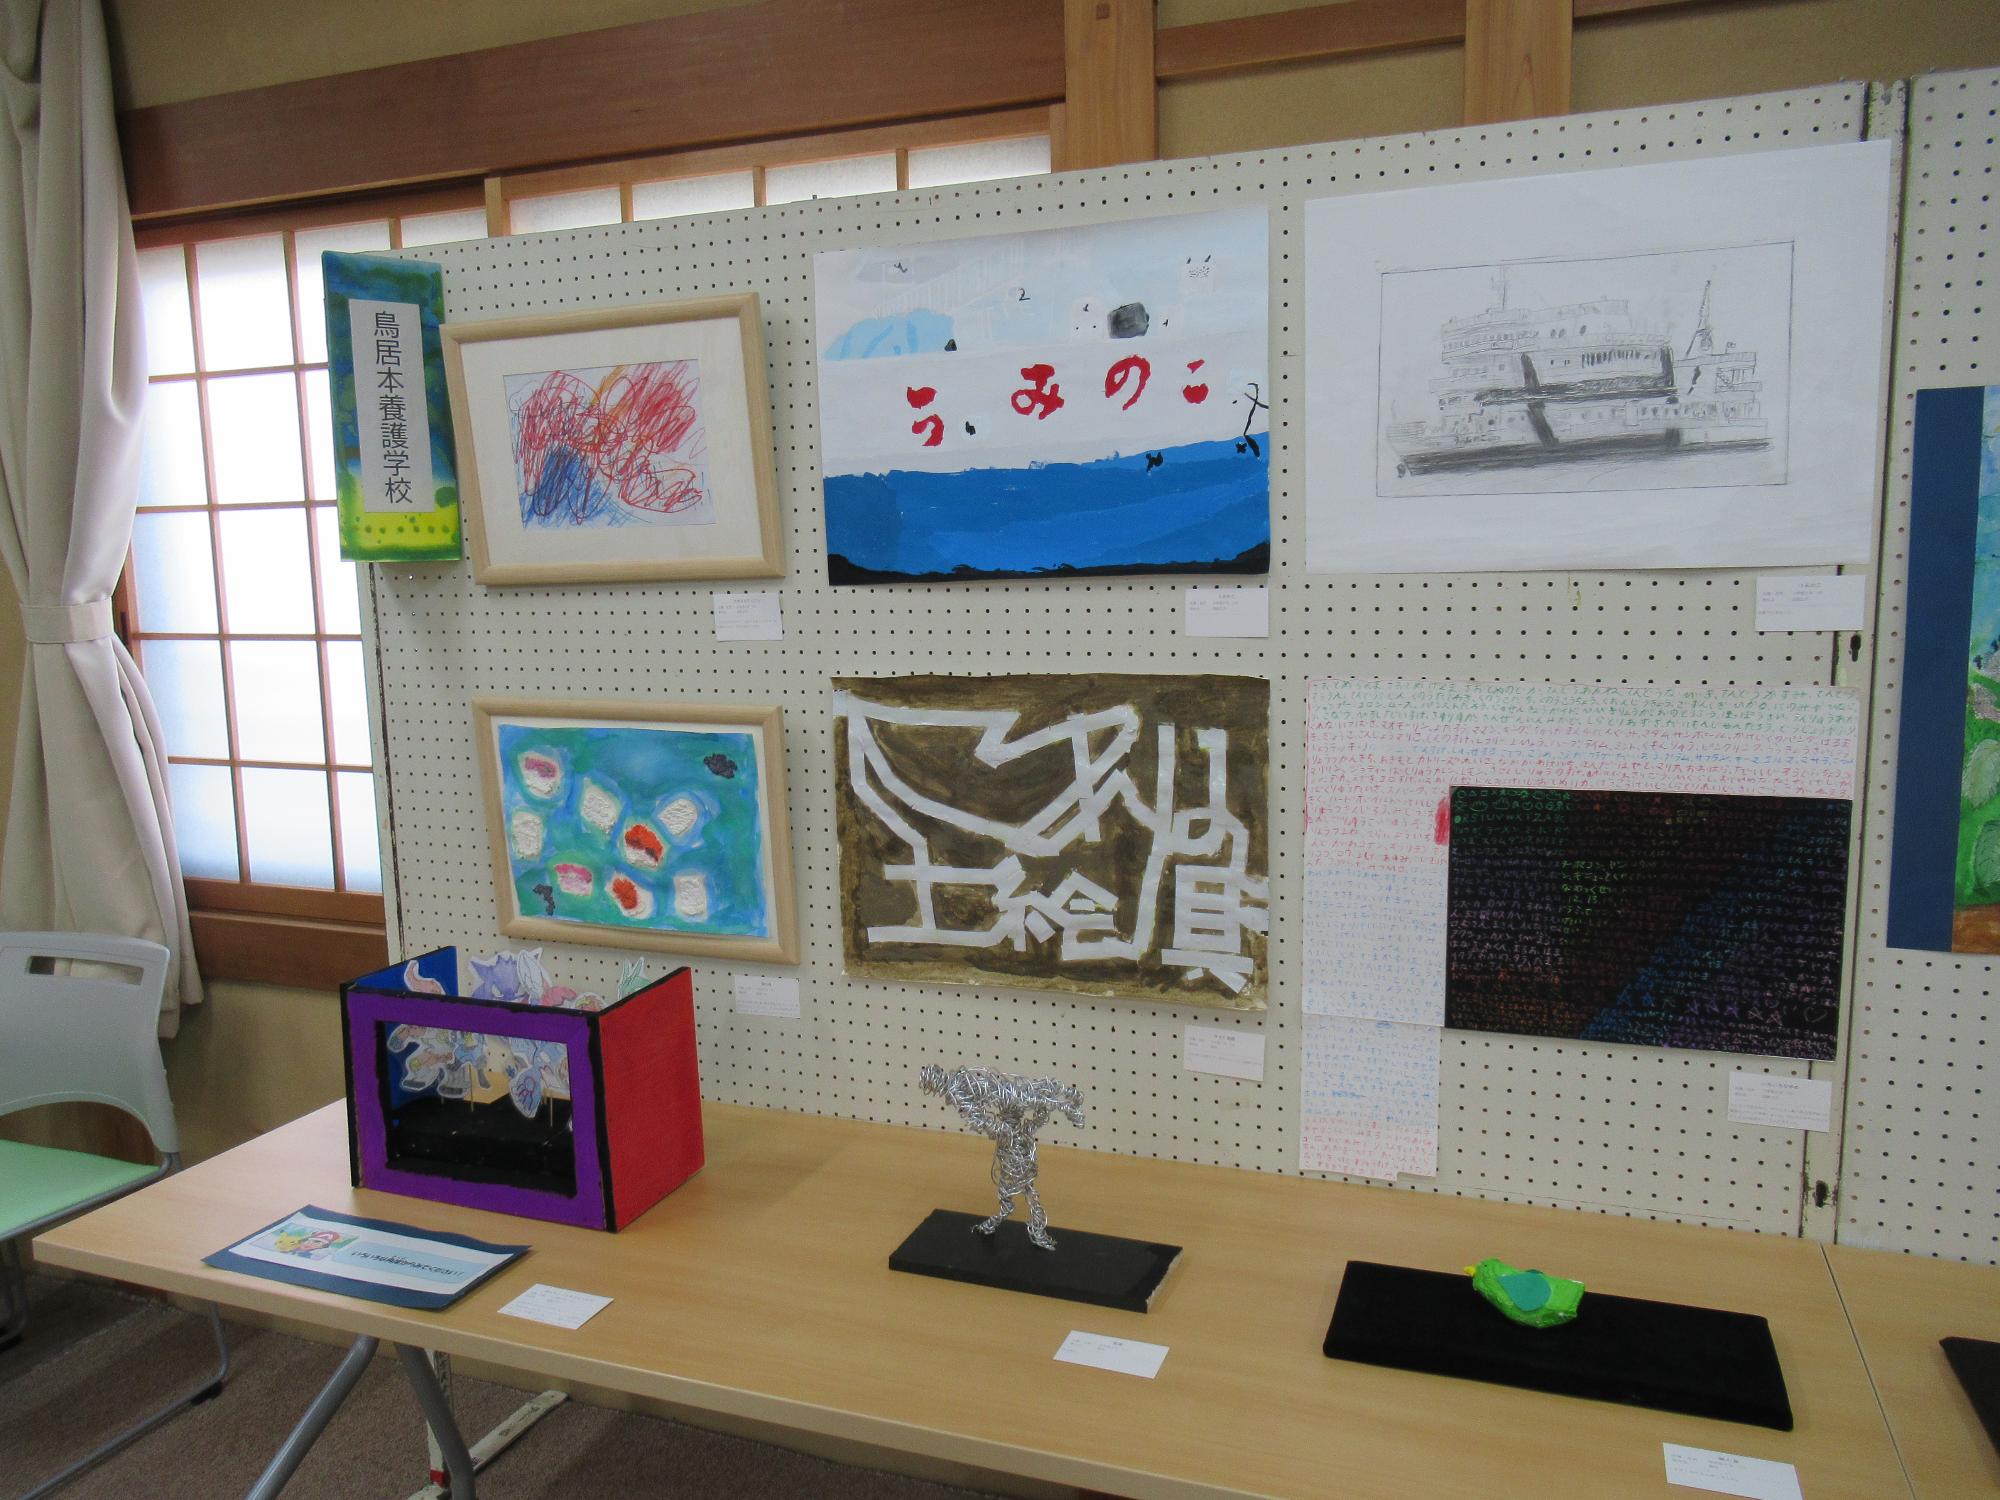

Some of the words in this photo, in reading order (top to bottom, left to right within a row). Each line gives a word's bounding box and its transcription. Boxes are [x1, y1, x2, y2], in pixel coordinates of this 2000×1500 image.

[374, 311, 413, 504] 鳥居本養護学校
